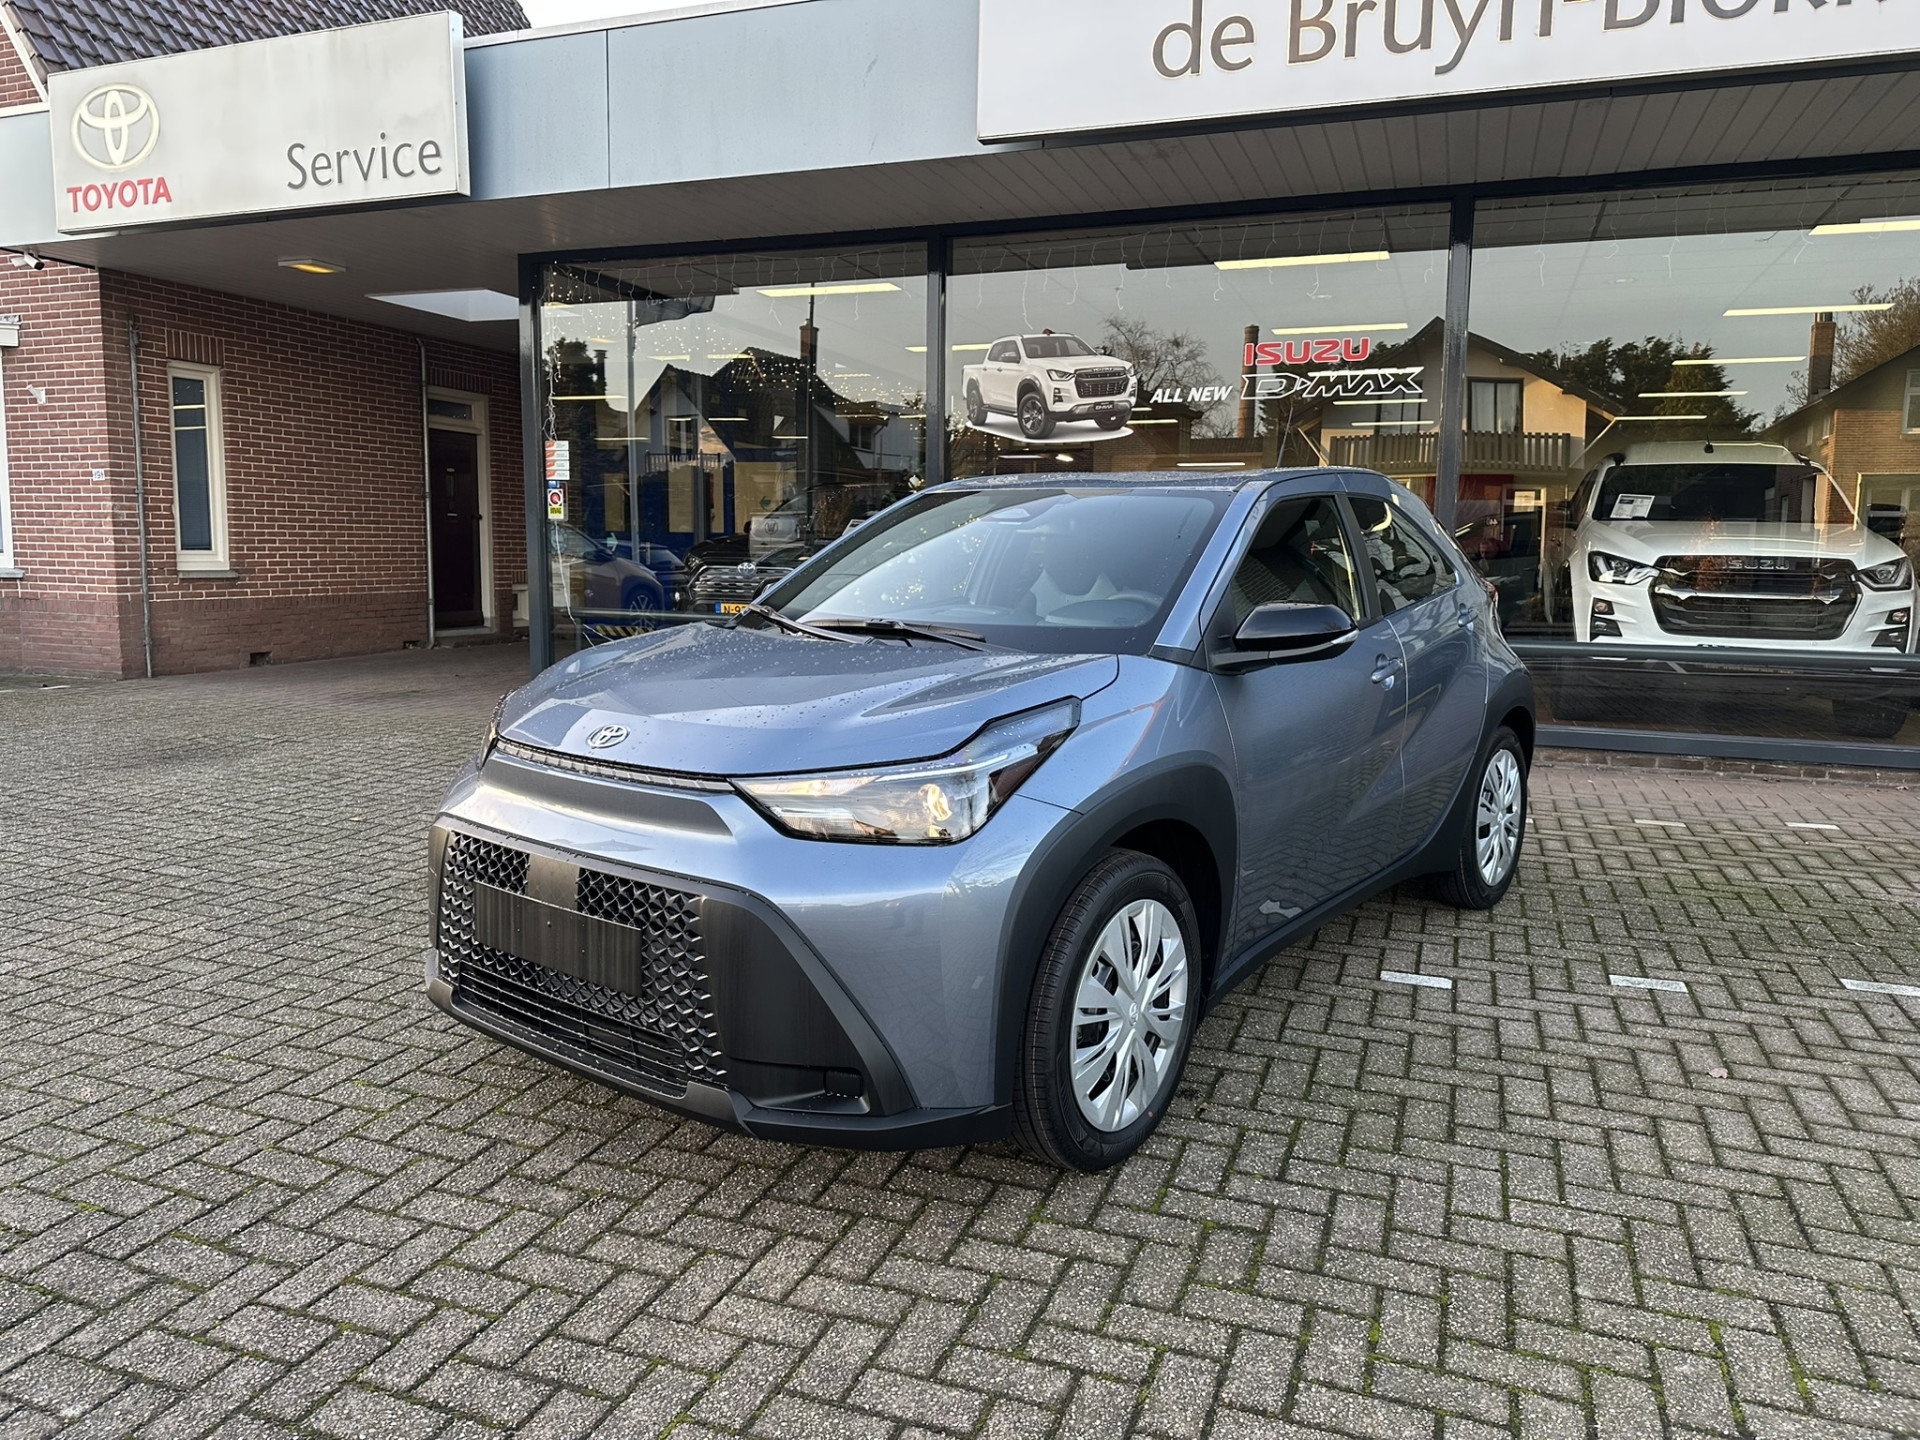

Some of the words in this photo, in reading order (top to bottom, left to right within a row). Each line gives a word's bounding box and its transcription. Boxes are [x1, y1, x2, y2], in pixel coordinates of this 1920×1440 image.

[1152, 0, 1255, 78] de
[287, 132, 441, 189] Service
[66, 177, 172, 213] TOYOTA
[1244, 337, 1370, 366] ISUZU
[1150, 386, 1186, 403] ALL
[1187, 385, 1233, 401] NEW
